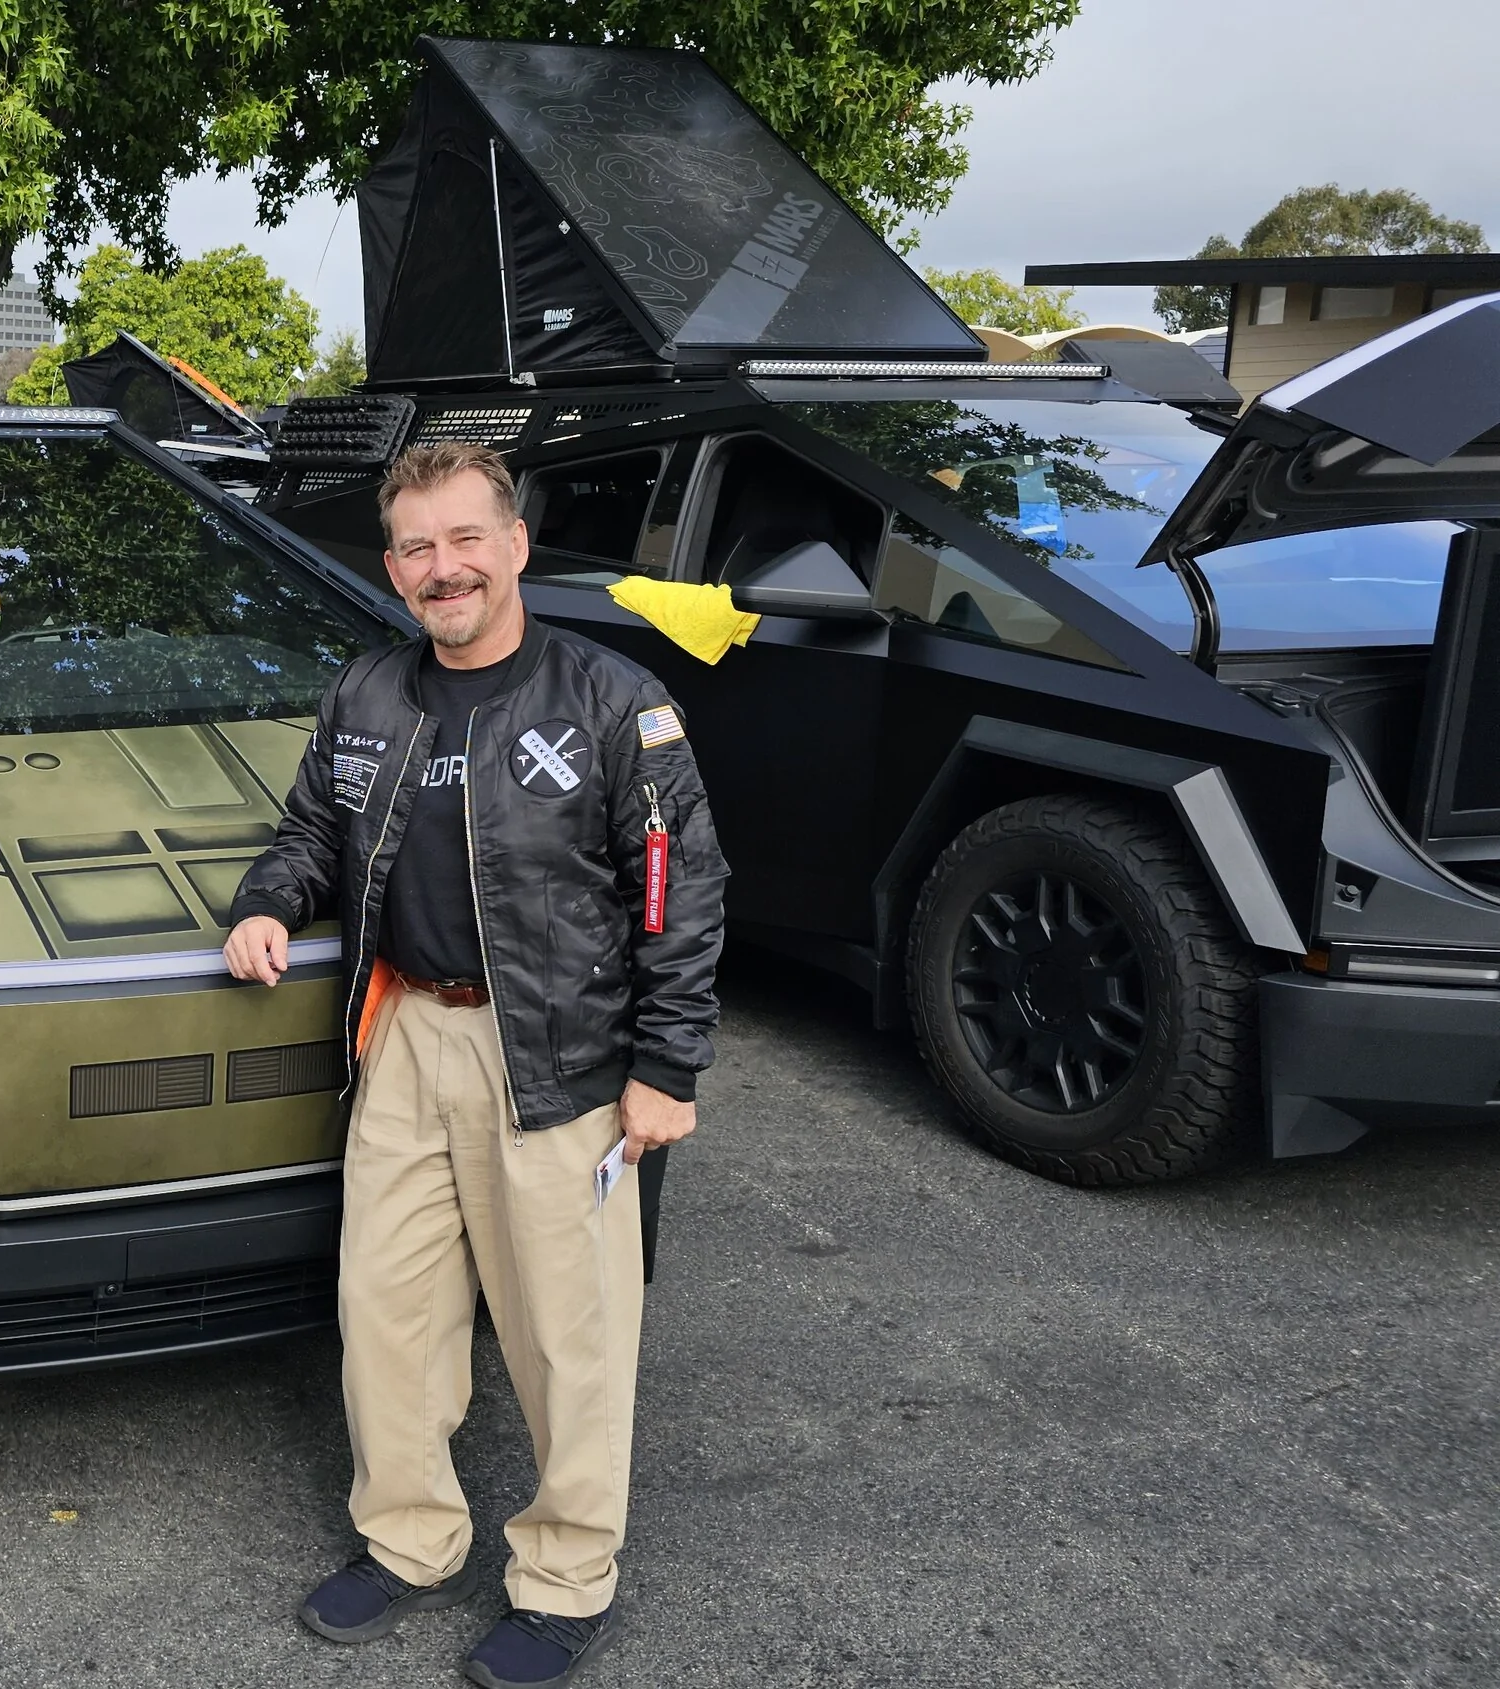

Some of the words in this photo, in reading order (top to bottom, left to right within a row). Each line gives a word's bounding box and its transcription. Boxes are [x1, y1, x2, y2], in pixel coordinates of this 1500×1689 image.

[754, 192, 824, 254] MARS
[552, 308, 574, 322] MARS
[529, 738, 571, 782] TAKEOVER
[652, 847, 661, 876] REMOVE
[650, 875, 660, 902] BEFORE
[649, 902, 658, 926] FLIGHT
